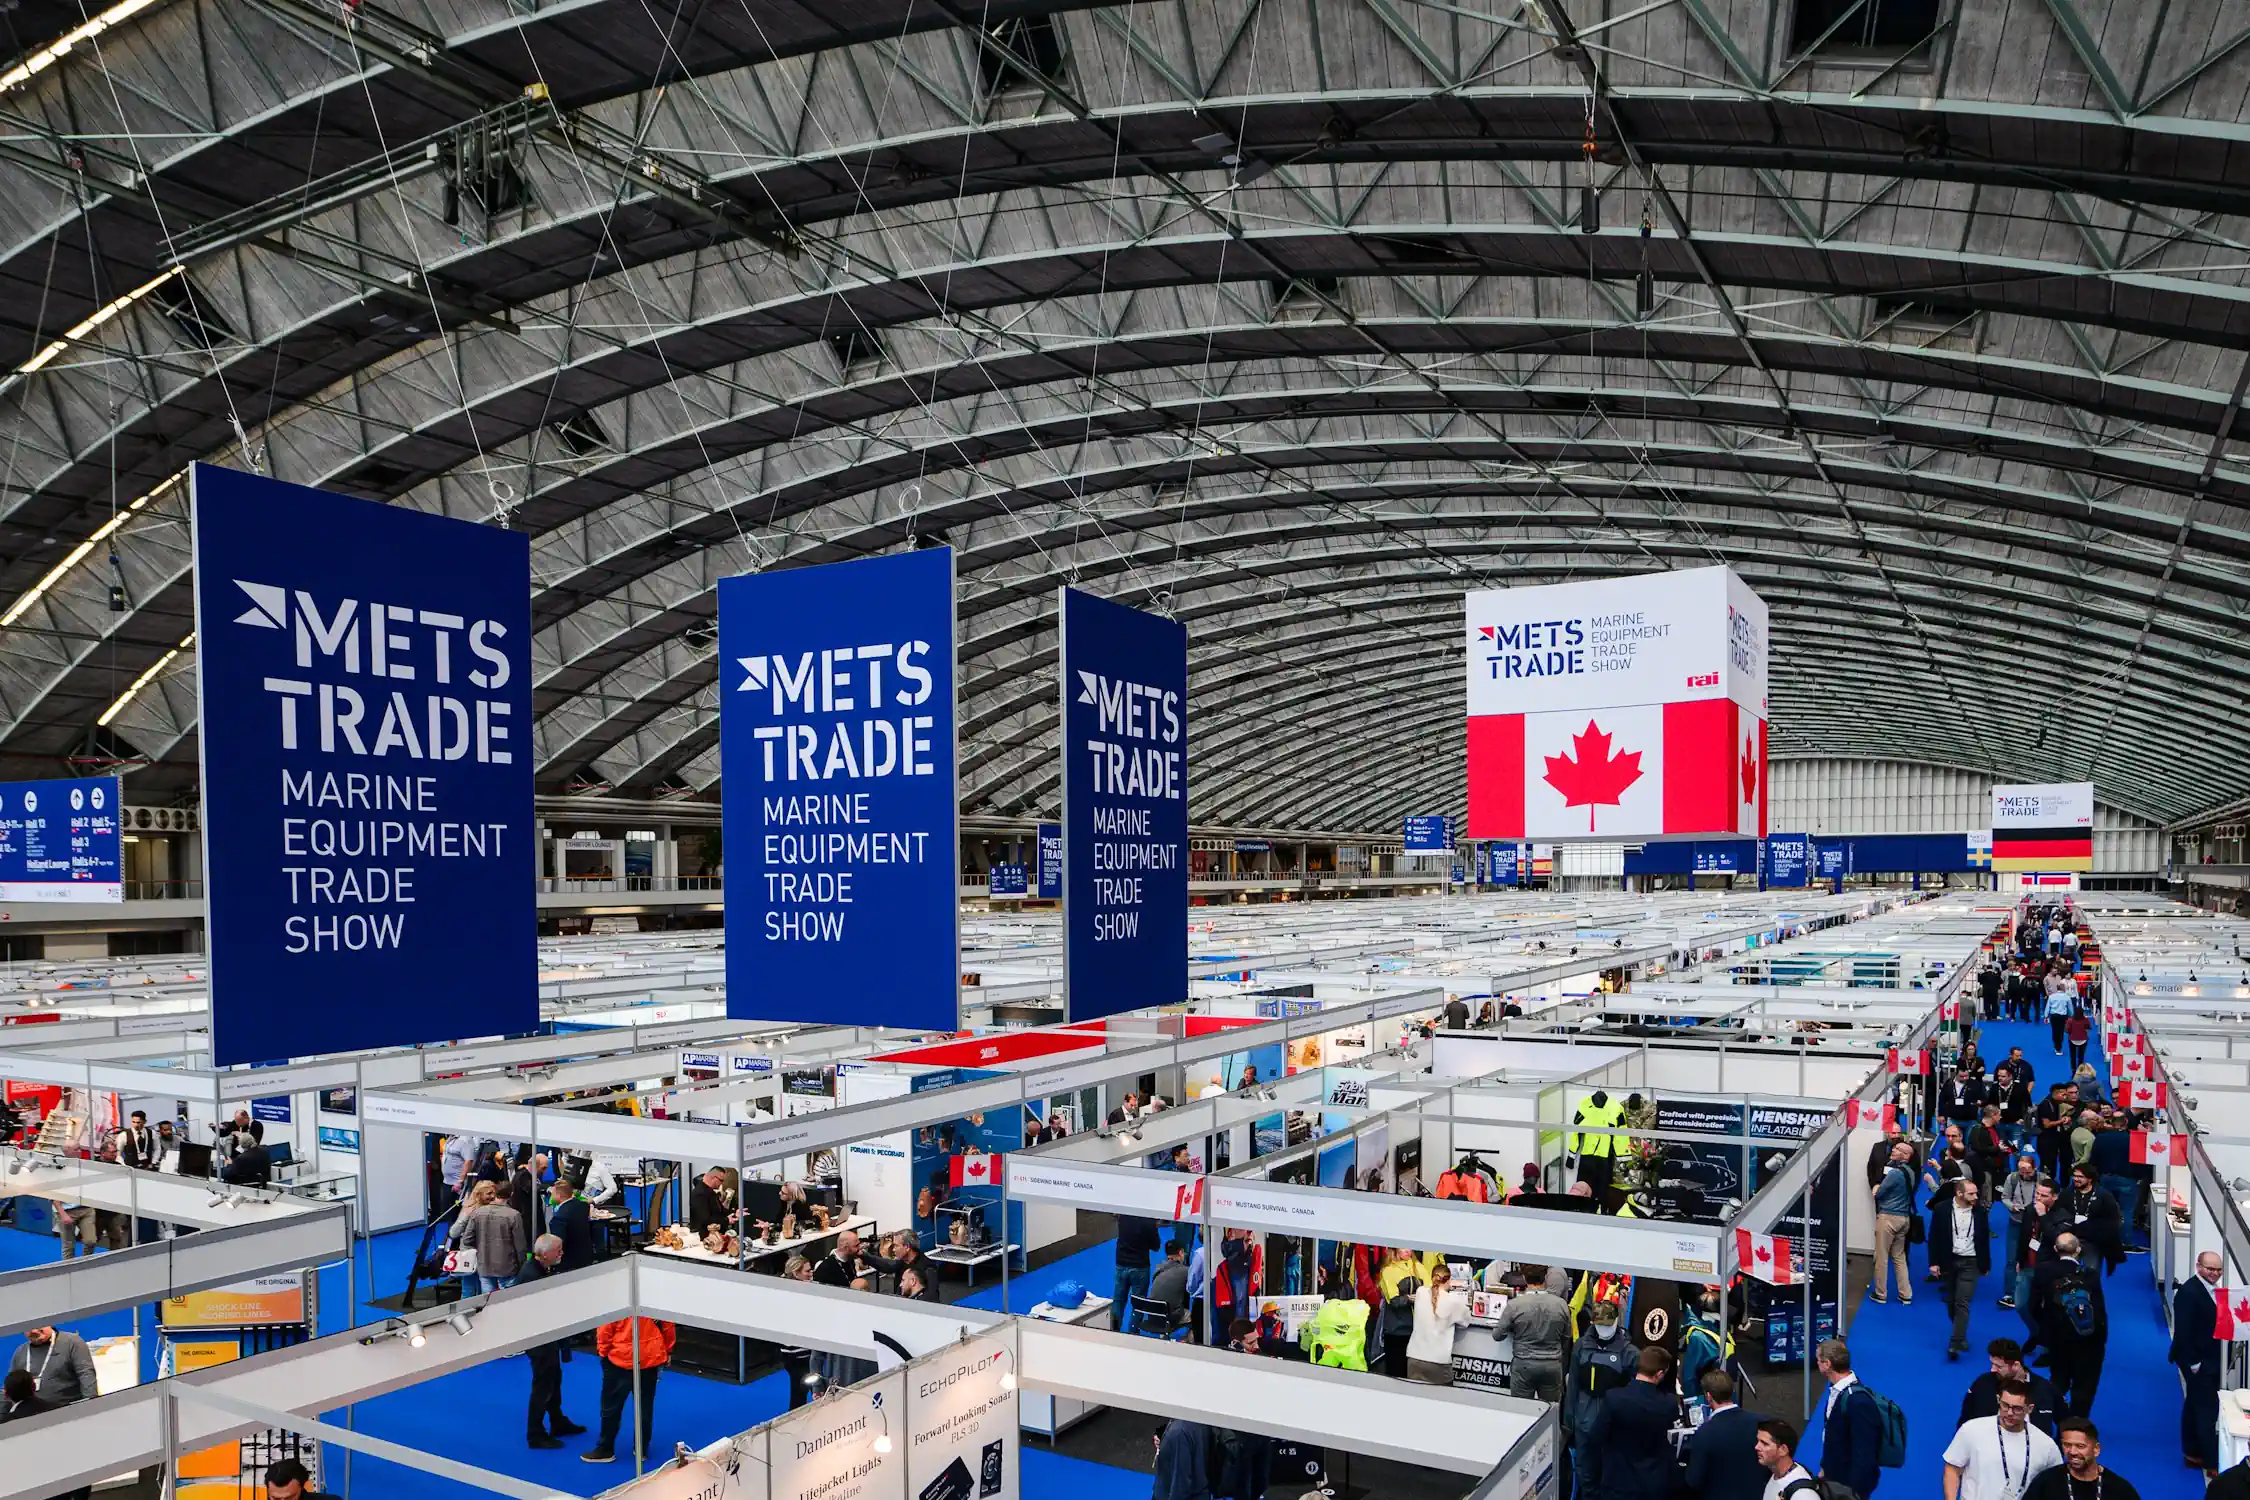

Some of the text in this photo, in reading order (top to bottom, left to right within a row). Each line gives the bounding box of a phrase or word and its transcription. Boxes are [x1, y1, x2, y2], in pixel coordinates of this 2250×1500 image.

[295, 590, 511, 689] METS
[1497, 612, 1644, 651] METS MARINE
[1591, 624, 1671, 644] EQUIPMENT
[1486, 643, 1636, 679] TRADE TRADE
[1591, 657, 1631, 673] SHOW
[773, 640, 933, 715] METS
[1687, 671, 1719, 688] rai
[264, 677, 512, 764] TRADE
[1099, 676, 1179, 743] METS
[754, 716, 934, 781] TRADE
[1088, 740, 1179, 799] TRADE
[282, 769, 437, 811] MARINE
[2004, 796, 2039, 807] METS
[764, 793, 870, 826] MARINE
[1093, 806, 1151, 836] MARINE
[2000, 807, 2040, 816] TRADE
[284, 818, 507, 857] EQUIPMENT
[764, 833, 929, 865] EQUIPMENT
[1046, 837, 1062, 849] MET
[1776, 842, 1803, 850] METS
[1043, 849, 1062, 859] TRAD
[1094, 842, 1178, 870] EQUIPMENT
[283, 867, 416, 903] TRADE
[764, 873, 853, 902] TRADE
[1093, 877, 1143, 905] TRADE
[285, 914, 404, 953] SHOW
[765, 911, 845, 941] SHOW
[1094, 912, 1138, 941] SHOW
[683, 1053, 719, 1065] AP MARINE
[734, 1058, 772, 1069] AP MARINE
[1659, 1110, 1741, 1124] Crafted with precision
[1674, 1119, 1725, 1129] consideration
[1751, 1124, 1803, 1136] INFLATABL
[1030, 1177, 1052, 1185] SIDEWIND
[1236, 1201, 1261, 1209] MUSTANG
[1262, 1204, 1288, 1213] SURVIVAL
[1292, 1207, 1315, 1216] CANADA
[1786, 1216, 1821, 1225] MISSON
[1453, 1358, 1511, 1377] ENSHAW
[1453, 1373, 1501, 1386] LATABLES
[914, 1390, 1012, 1446] Forward Looking Sonar
[951, 1421, 980, 1443] FLS 3D
[796, 1415, 868, 1460] Daniamant
[852, 1456, 882, 1478] Lights
